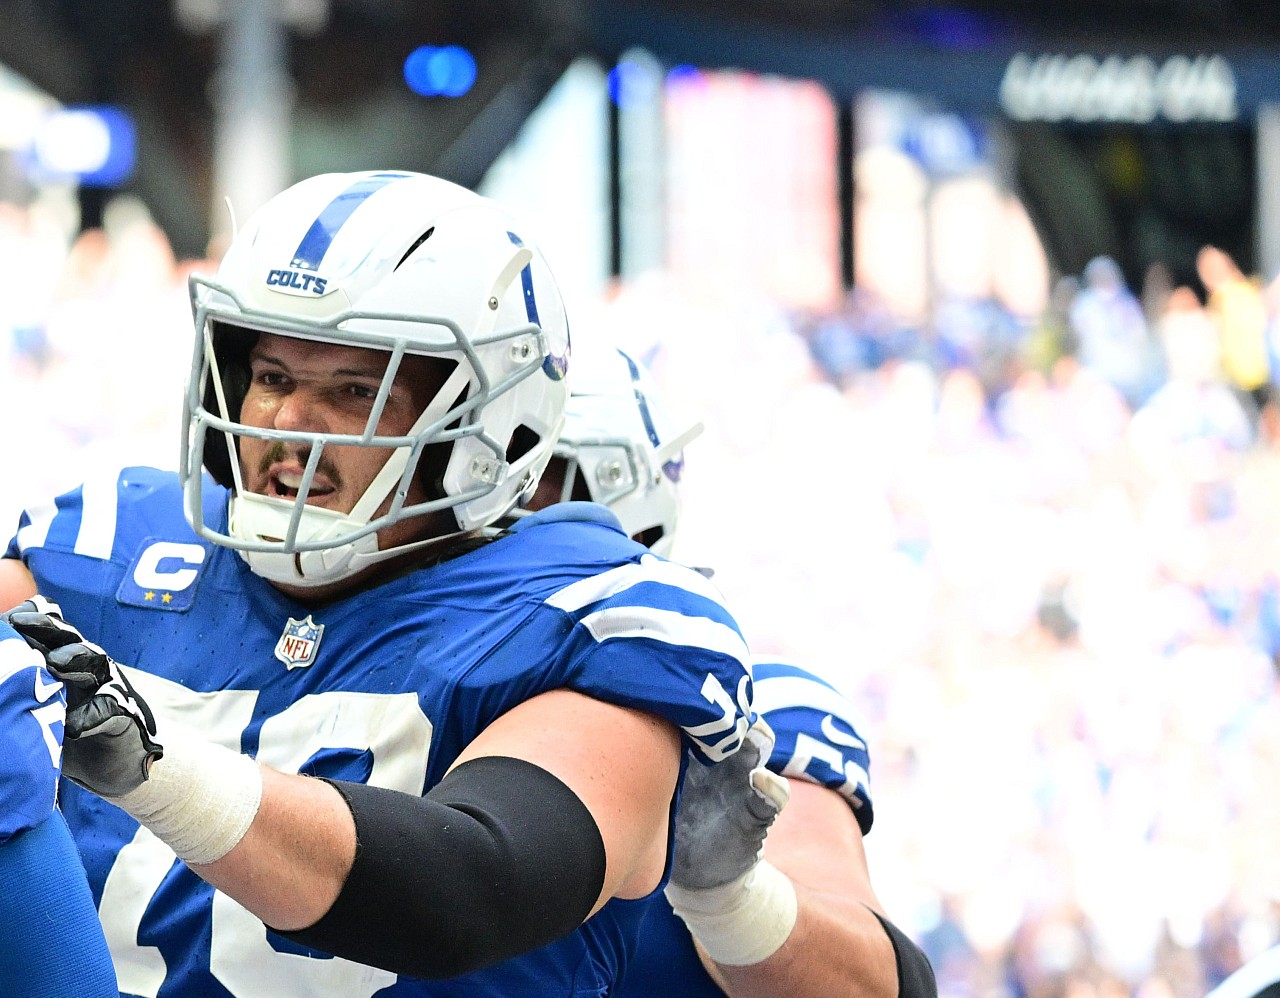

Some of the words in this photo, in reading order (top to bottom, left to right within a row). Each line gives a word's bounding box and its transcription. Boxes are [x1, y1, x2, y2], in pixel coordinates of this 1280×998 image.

[266, 269, 328, 295] COLTS
[133, 541, 206, 591] C
[282, 637, 310, 660] NFL
